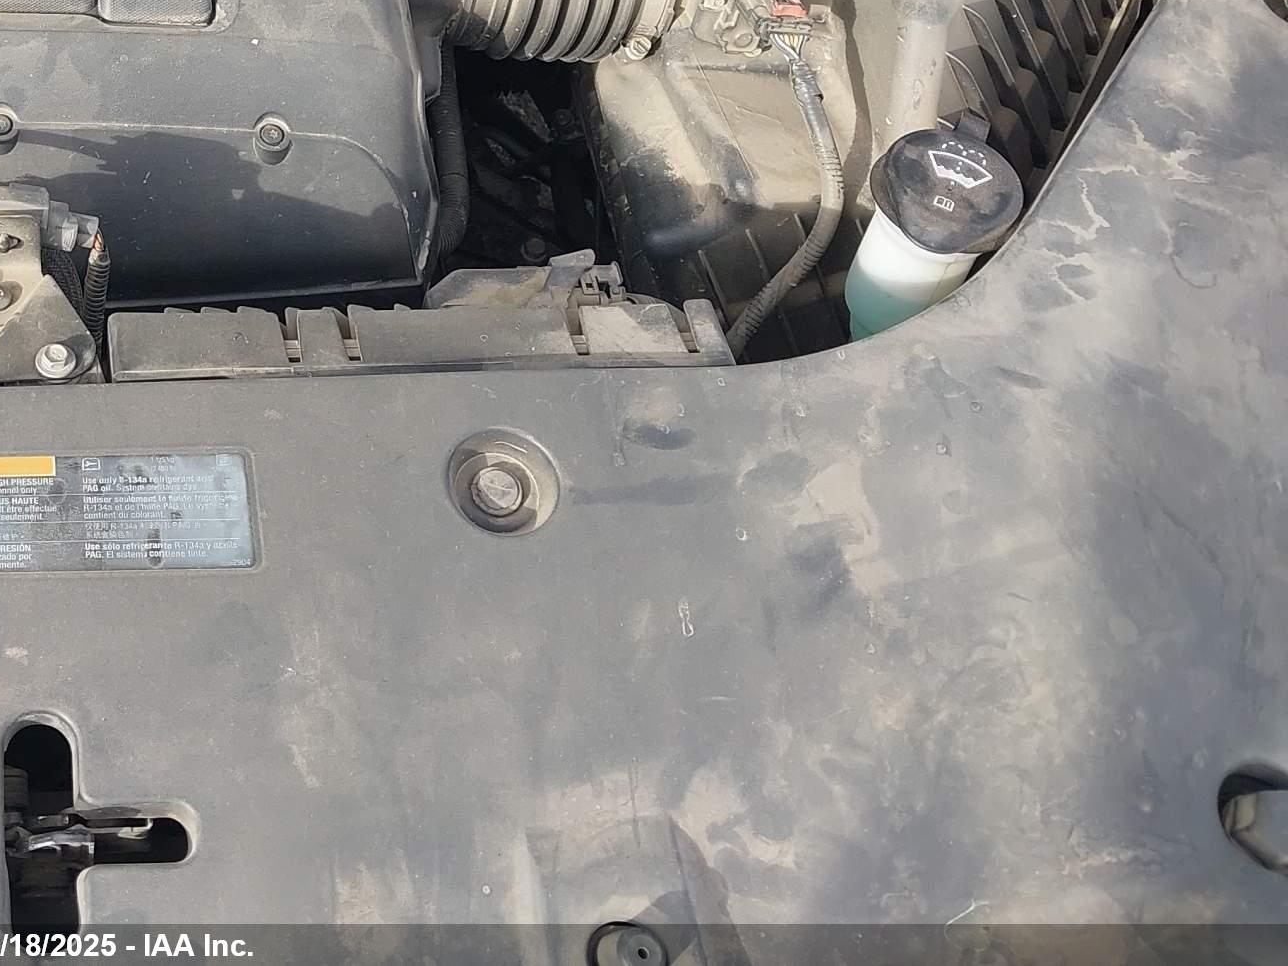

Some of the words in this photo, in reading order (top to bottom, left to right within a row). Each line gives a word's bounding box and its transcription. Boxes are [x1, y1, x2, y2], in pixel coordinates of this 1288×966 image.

[11, 477, 54, 486] PRESSURE
[82, 476, 97, 484] Use
[98, 475, 117, 485] only
[119, 475, 148, 484] R-134a
[82, 484, 99, 492] PAG
[11, 496, 39, 505] HAUTE
[83, 503, 113, 512] R-134a
[83, 511, 117, 520] contient
[118, 510, 129, 519] du
[85, 542, 101, 551] Use
[103, 542, 121, 551] sólo
[106, 550, 114, 559] El
[149, 549, 186, 559] contiene
